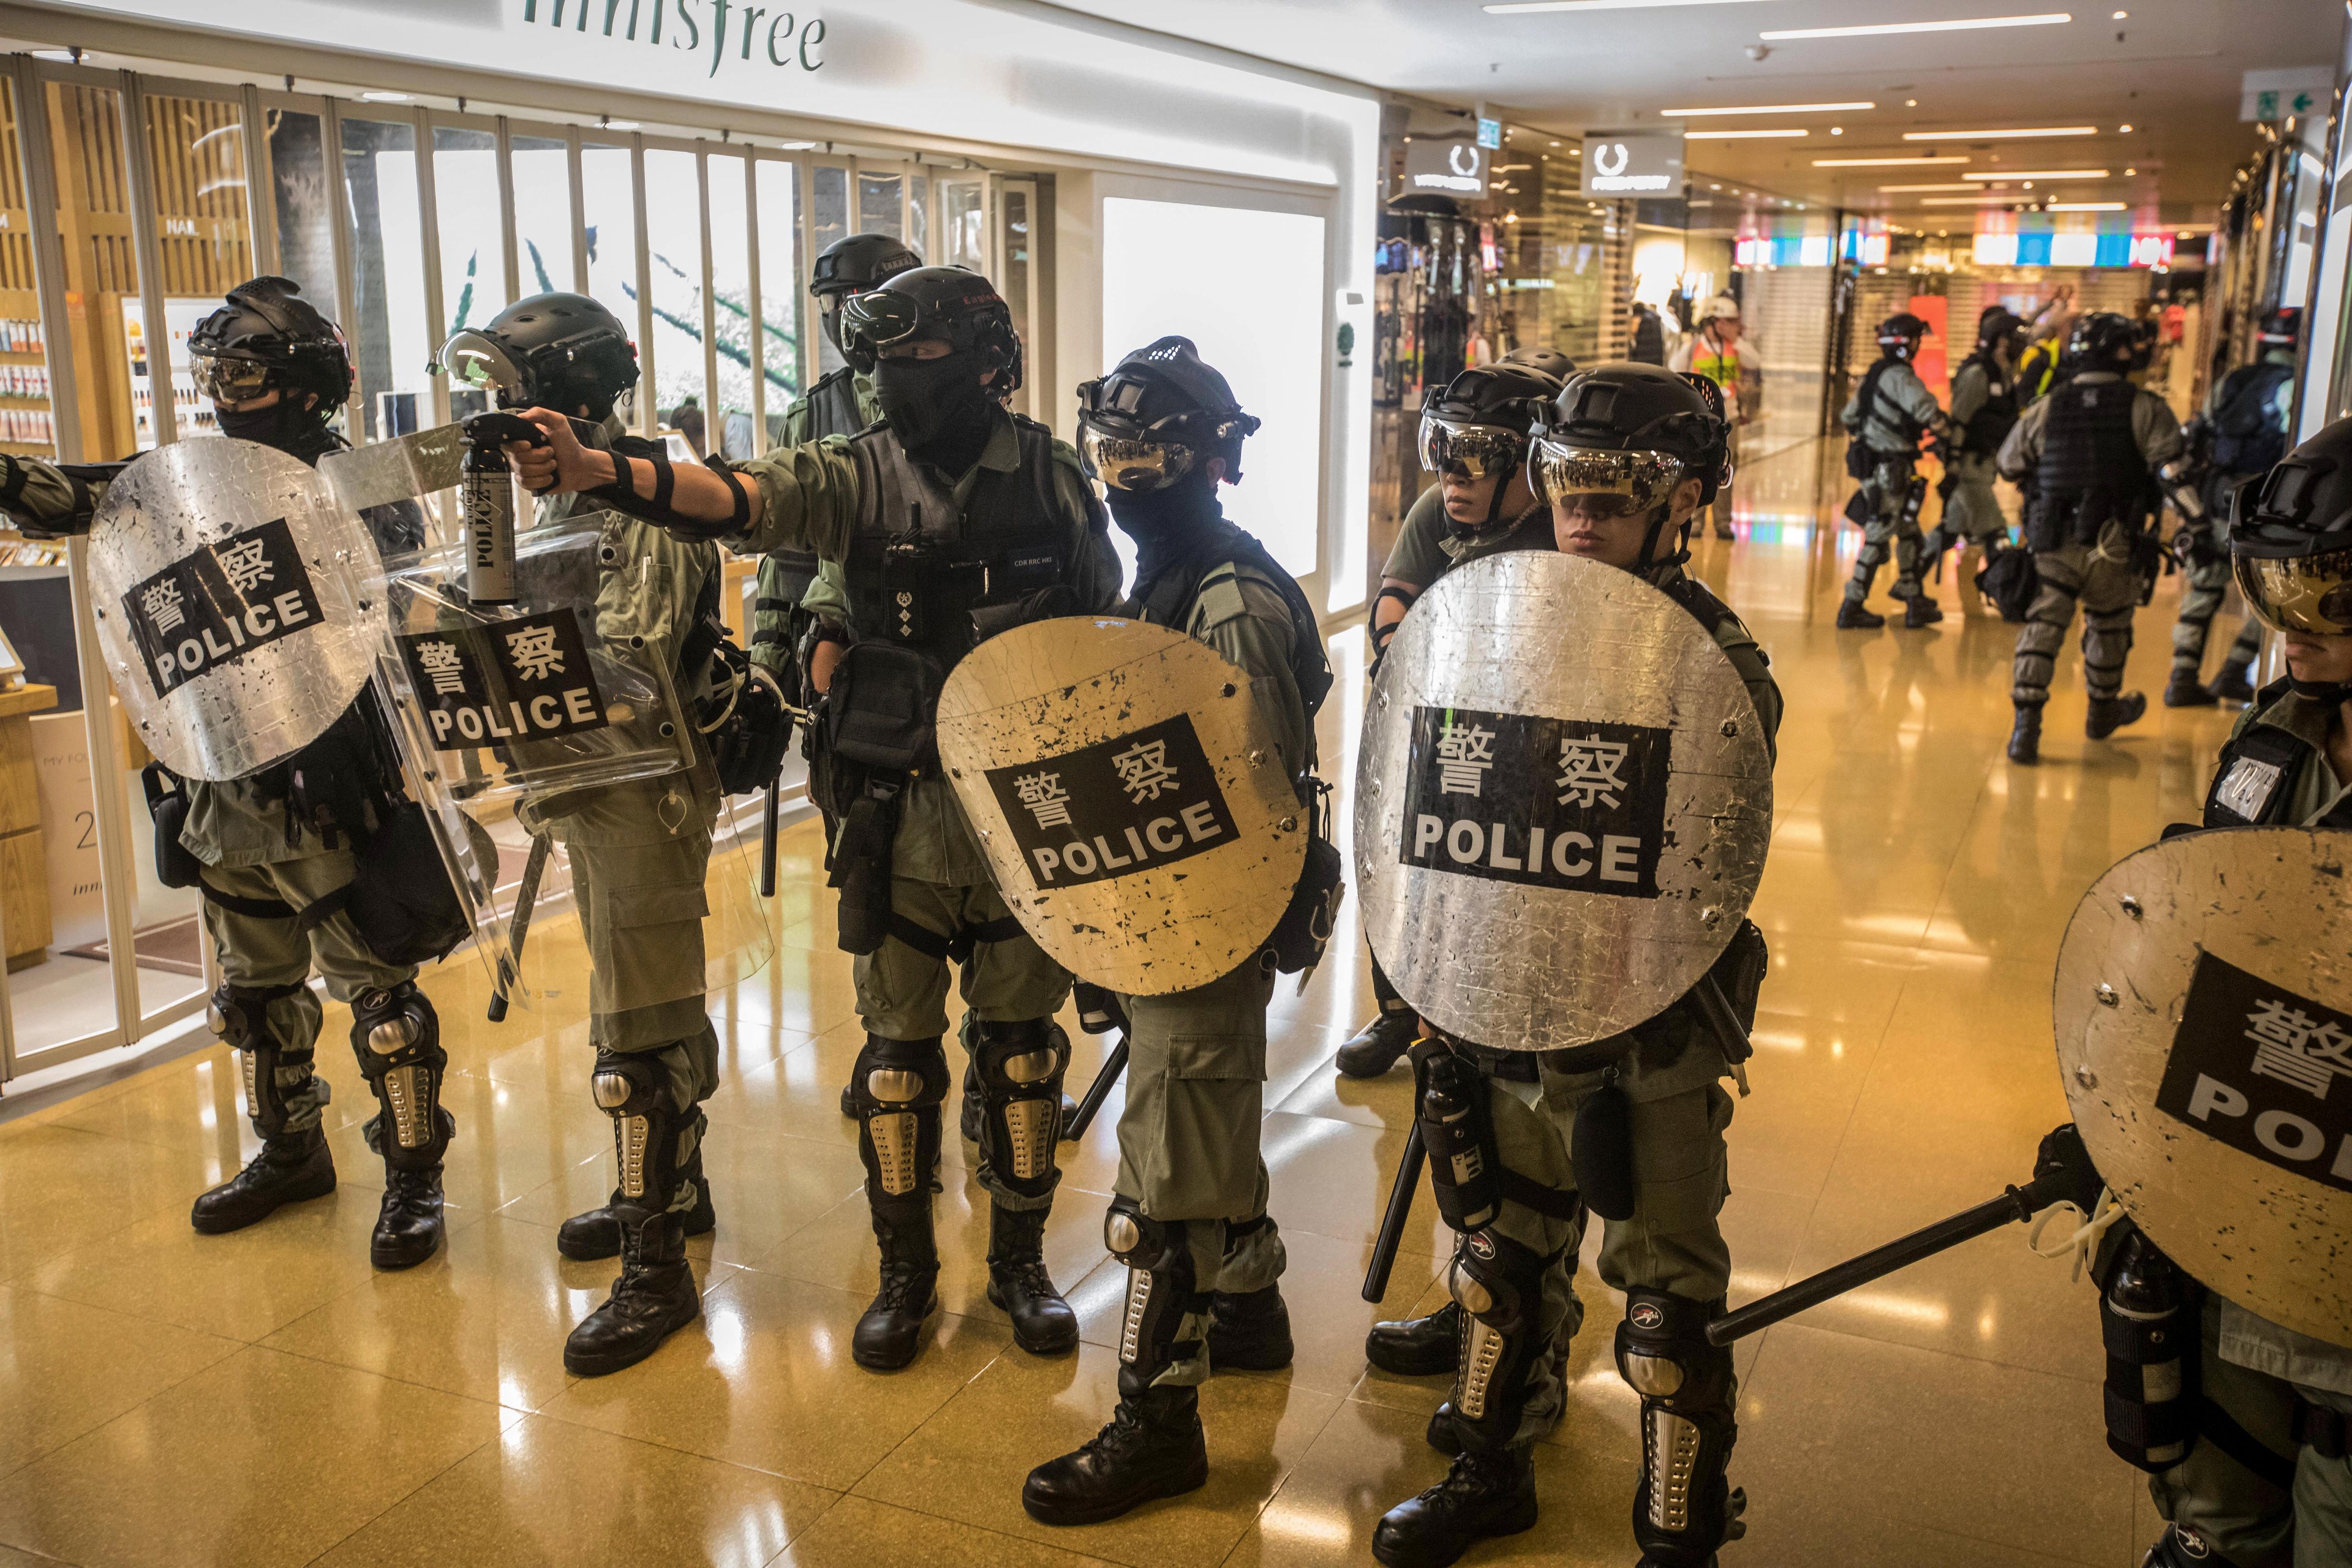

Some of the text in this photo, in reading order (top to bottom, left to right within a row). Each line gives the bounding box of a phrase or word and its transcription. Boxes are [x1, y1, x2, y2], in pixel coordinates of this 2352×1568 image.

[475, 489, 494, 568] POLICE
[154, 589, 309, 688] POLICE
[429, 687, 598, 742] POLICE
[1031, 800, 1223, 881] POLICE
[1414, 815, 1642, 883] POLICE
